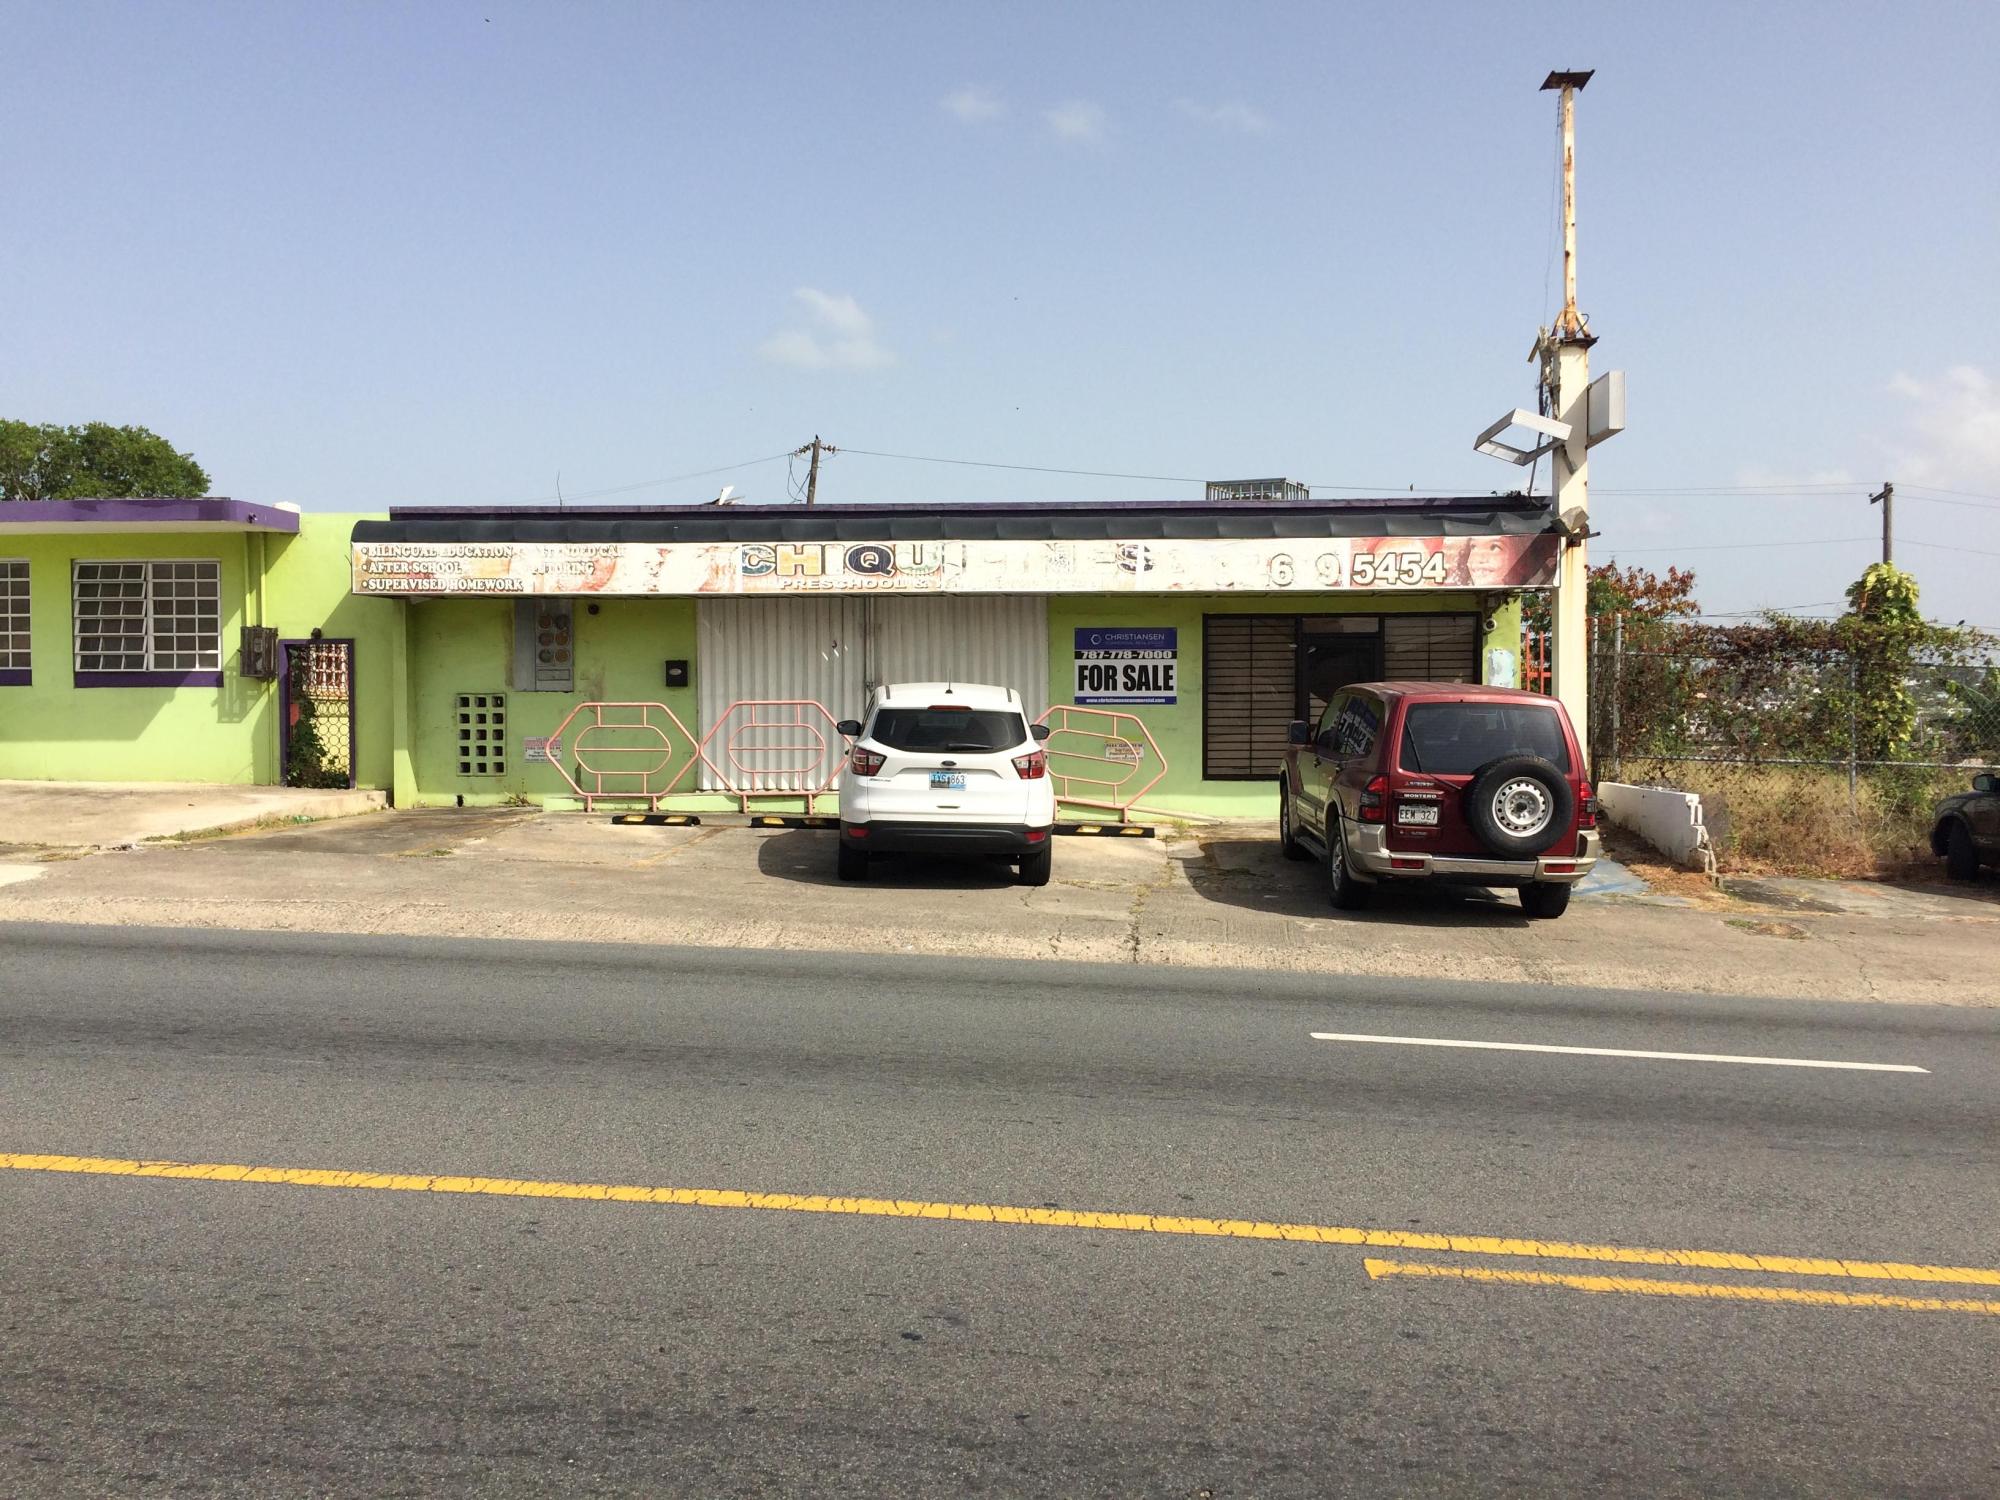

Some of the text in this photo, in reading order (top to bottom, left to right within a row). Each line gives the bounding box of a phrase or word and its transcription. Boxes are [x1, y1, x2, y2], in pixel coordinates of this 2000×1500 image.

[367, 545, 437, 558] BILINGUAL
[367, 577, 524, 592] SUPERVISED HOMEWORK
[780, 577, 907, 591] PRESCHOOL
[1082, 651, 1172, 659] 787-778-7000
[1078, 664, 1174, 692] FOR SALE
[950, 774, 965, 785] 863
[1420, 811, 1437, 820] 327
